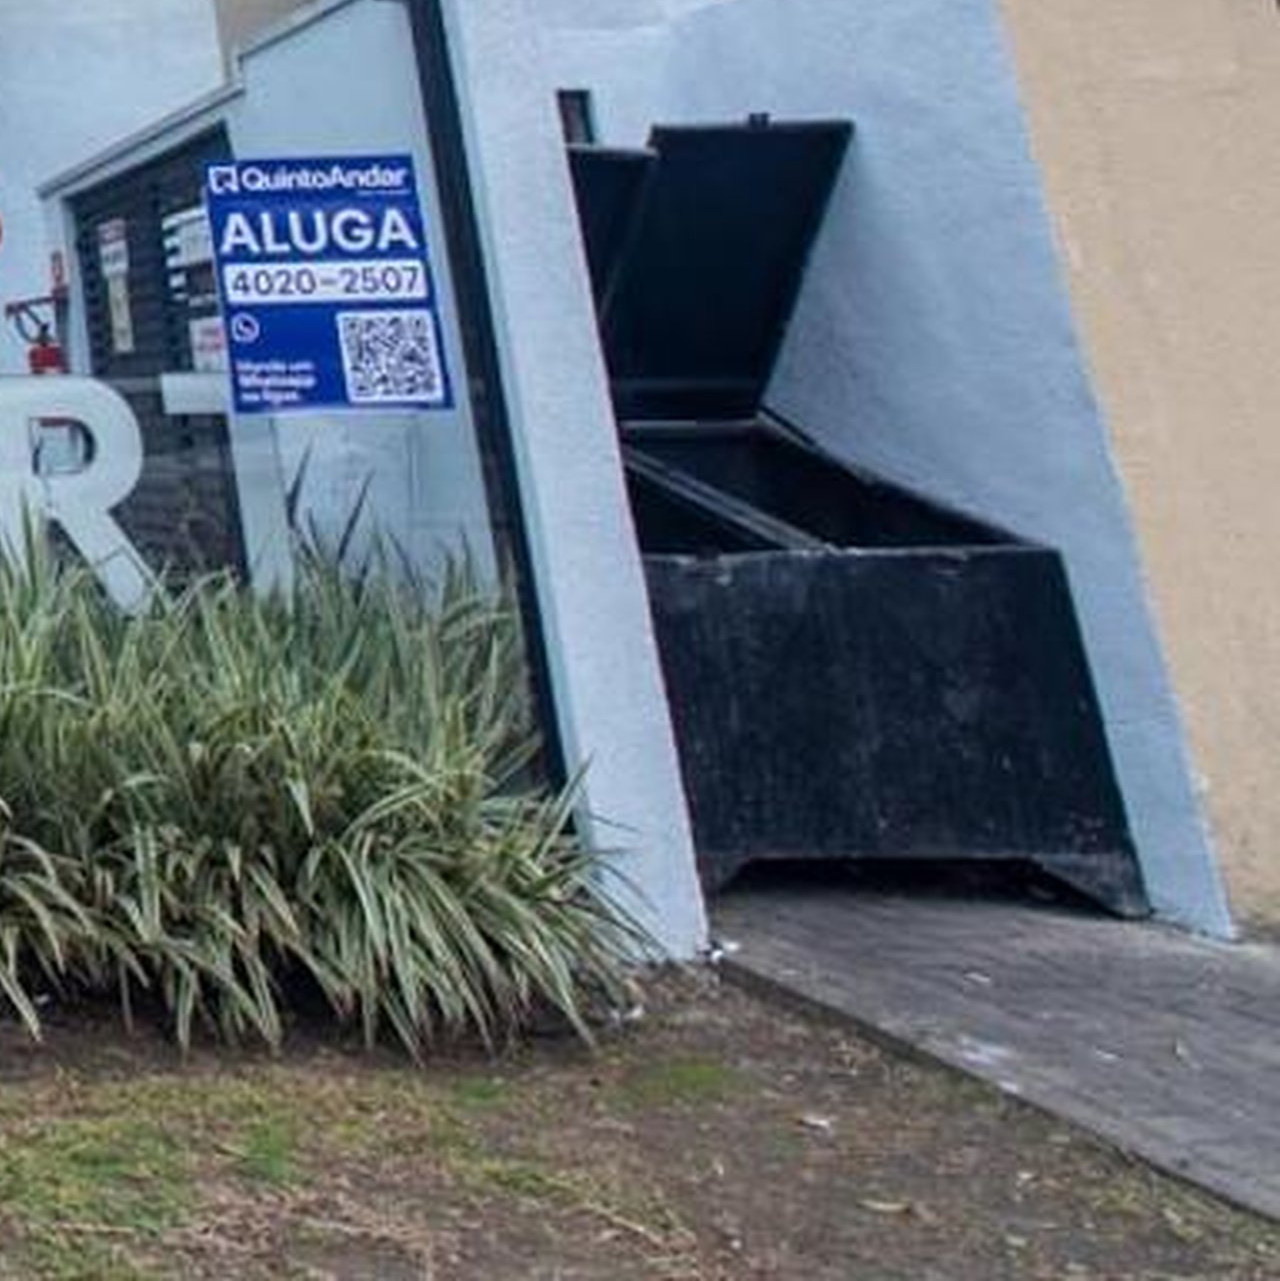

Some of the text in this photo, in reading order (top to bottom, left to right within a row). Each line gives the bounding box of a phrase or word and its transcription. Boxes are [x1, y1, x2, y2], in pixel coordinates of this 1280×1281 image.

[241, 165, 408, 191] QuintoAndar
[219, 208, 419, 255] ALUGA
[232, 266, 418, 296] 4020-2507
